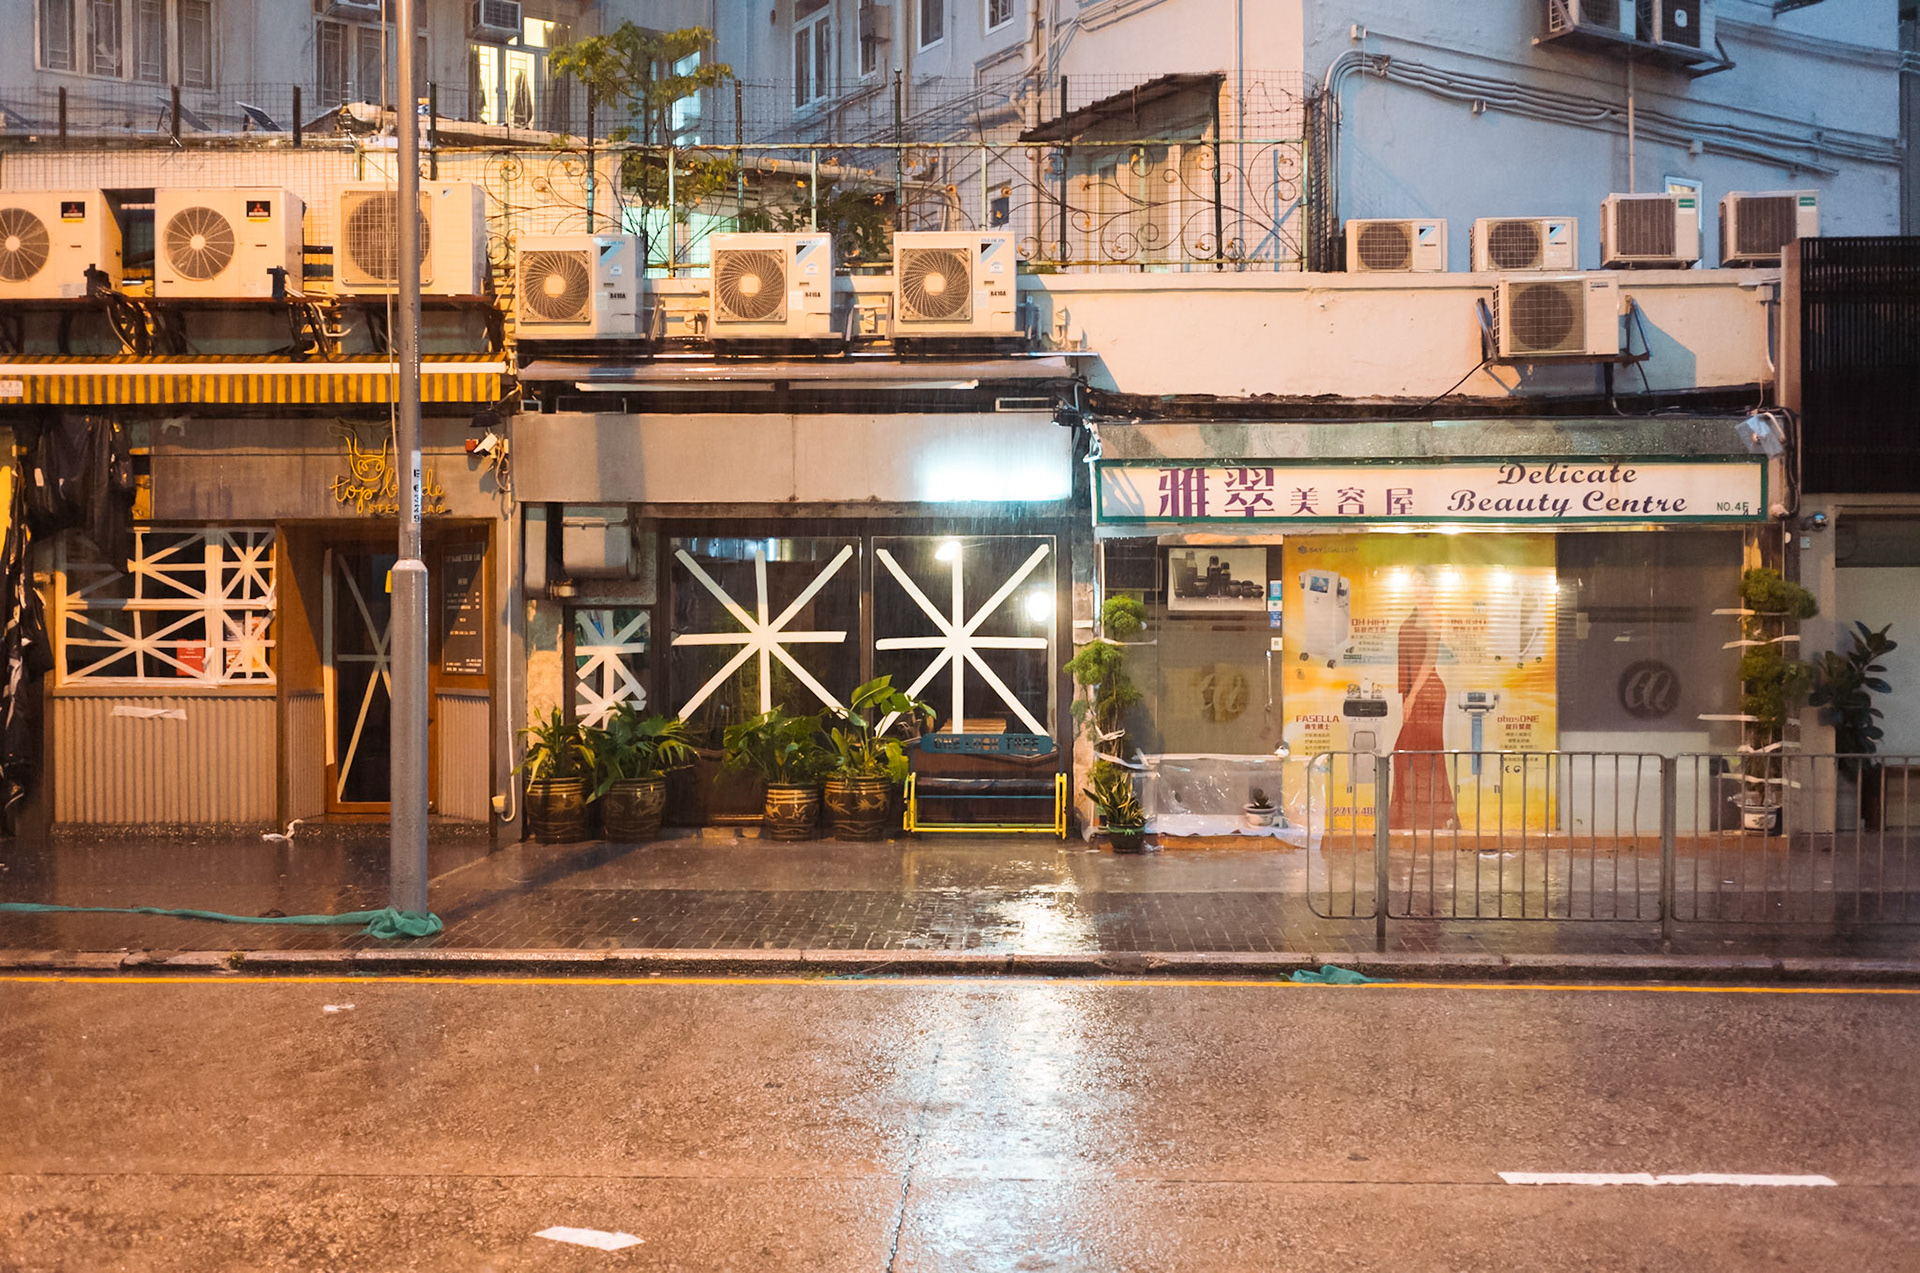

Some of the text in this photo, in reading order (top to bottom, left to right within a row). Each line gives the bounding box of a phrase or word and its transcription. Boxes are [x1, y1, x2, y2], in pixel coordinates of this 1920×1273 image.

[1497, 463, 1638, 485] Delicate
[329, 475, 378, 514] top
[1158, 467, 1414, 517] 雅翠美容屋
[1447, 489, 1573, 518] Beauty
[1582, 489, 1689, 514] Centre
[1296, 715, 1340, 723] FASELLA
[933, 737, 960, 750] ONE
[1005, 736, 1040, 751] TREE
